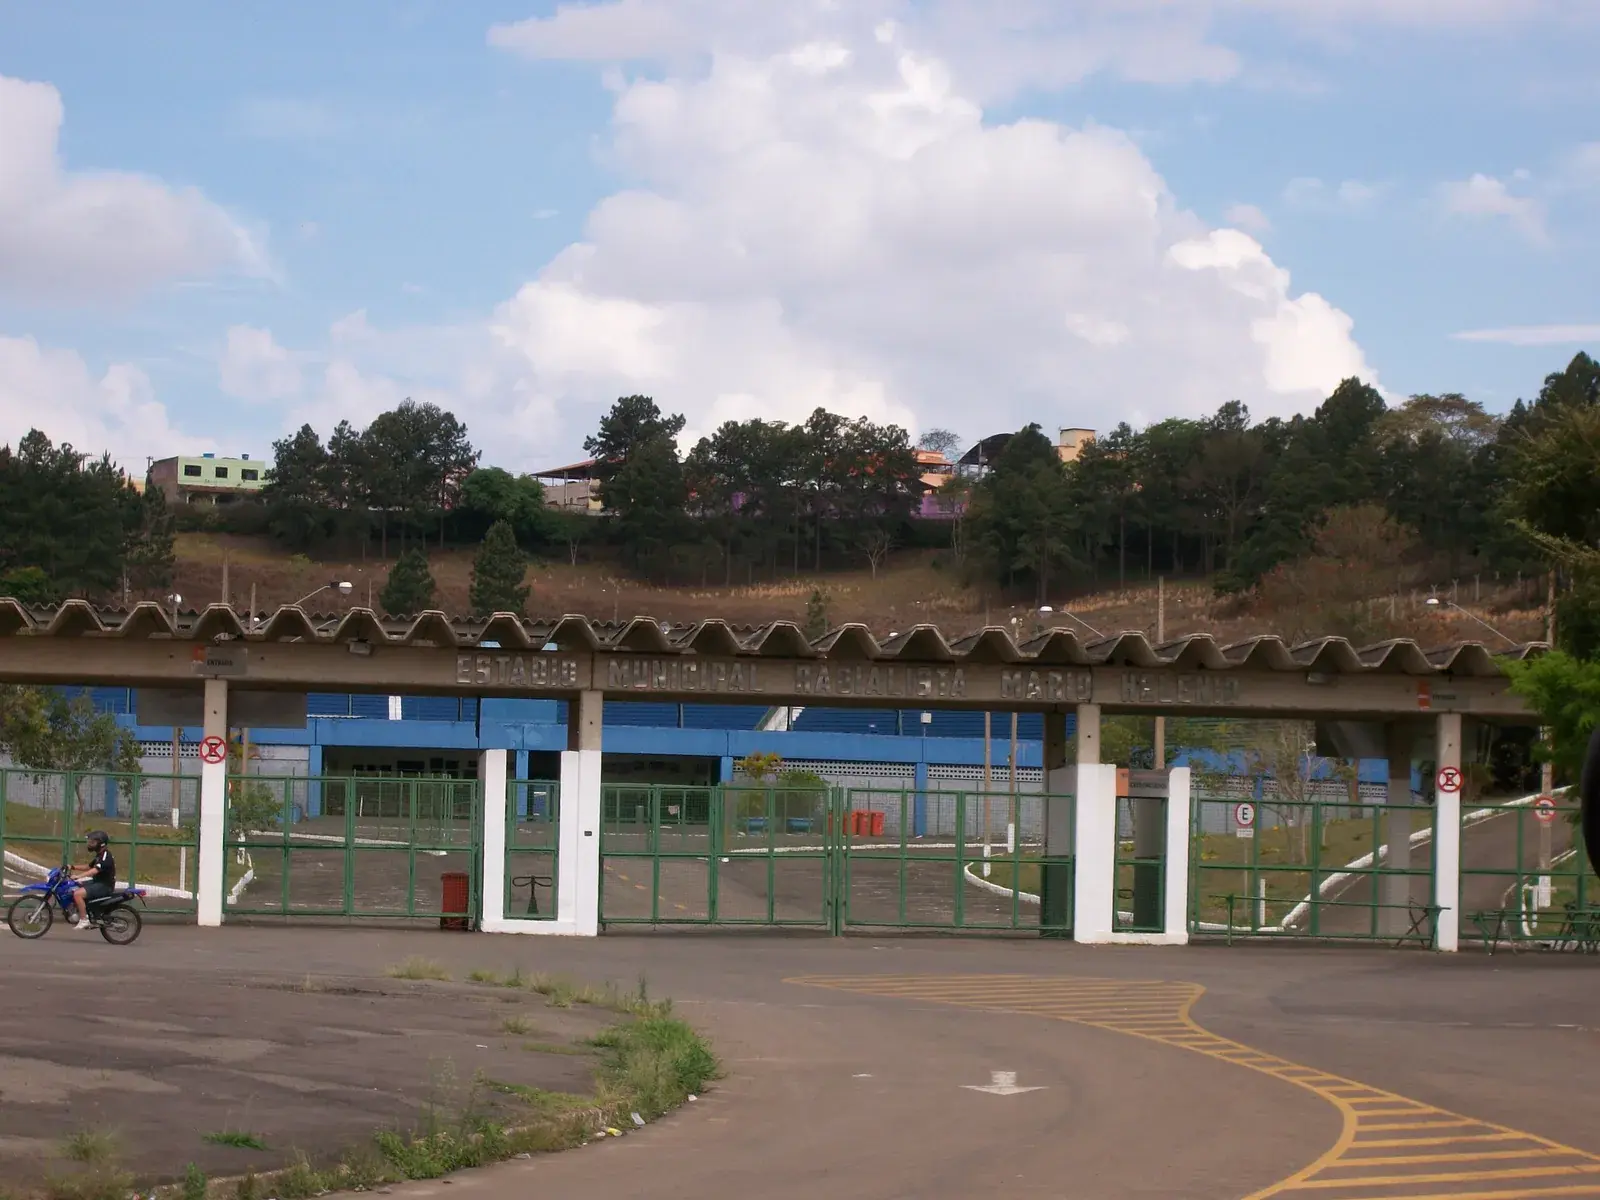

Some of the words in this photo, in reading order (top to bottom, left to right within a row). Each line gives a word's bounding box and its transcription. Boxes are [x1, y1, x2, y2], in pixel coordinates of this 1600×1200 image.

[456, 654, 577, 687] ESTADIO
[607, 658, 765, 692] MUNICIPAL
[1001, 668, 1093, 701] MARIO
[1242, 807, 1249, 821] E
